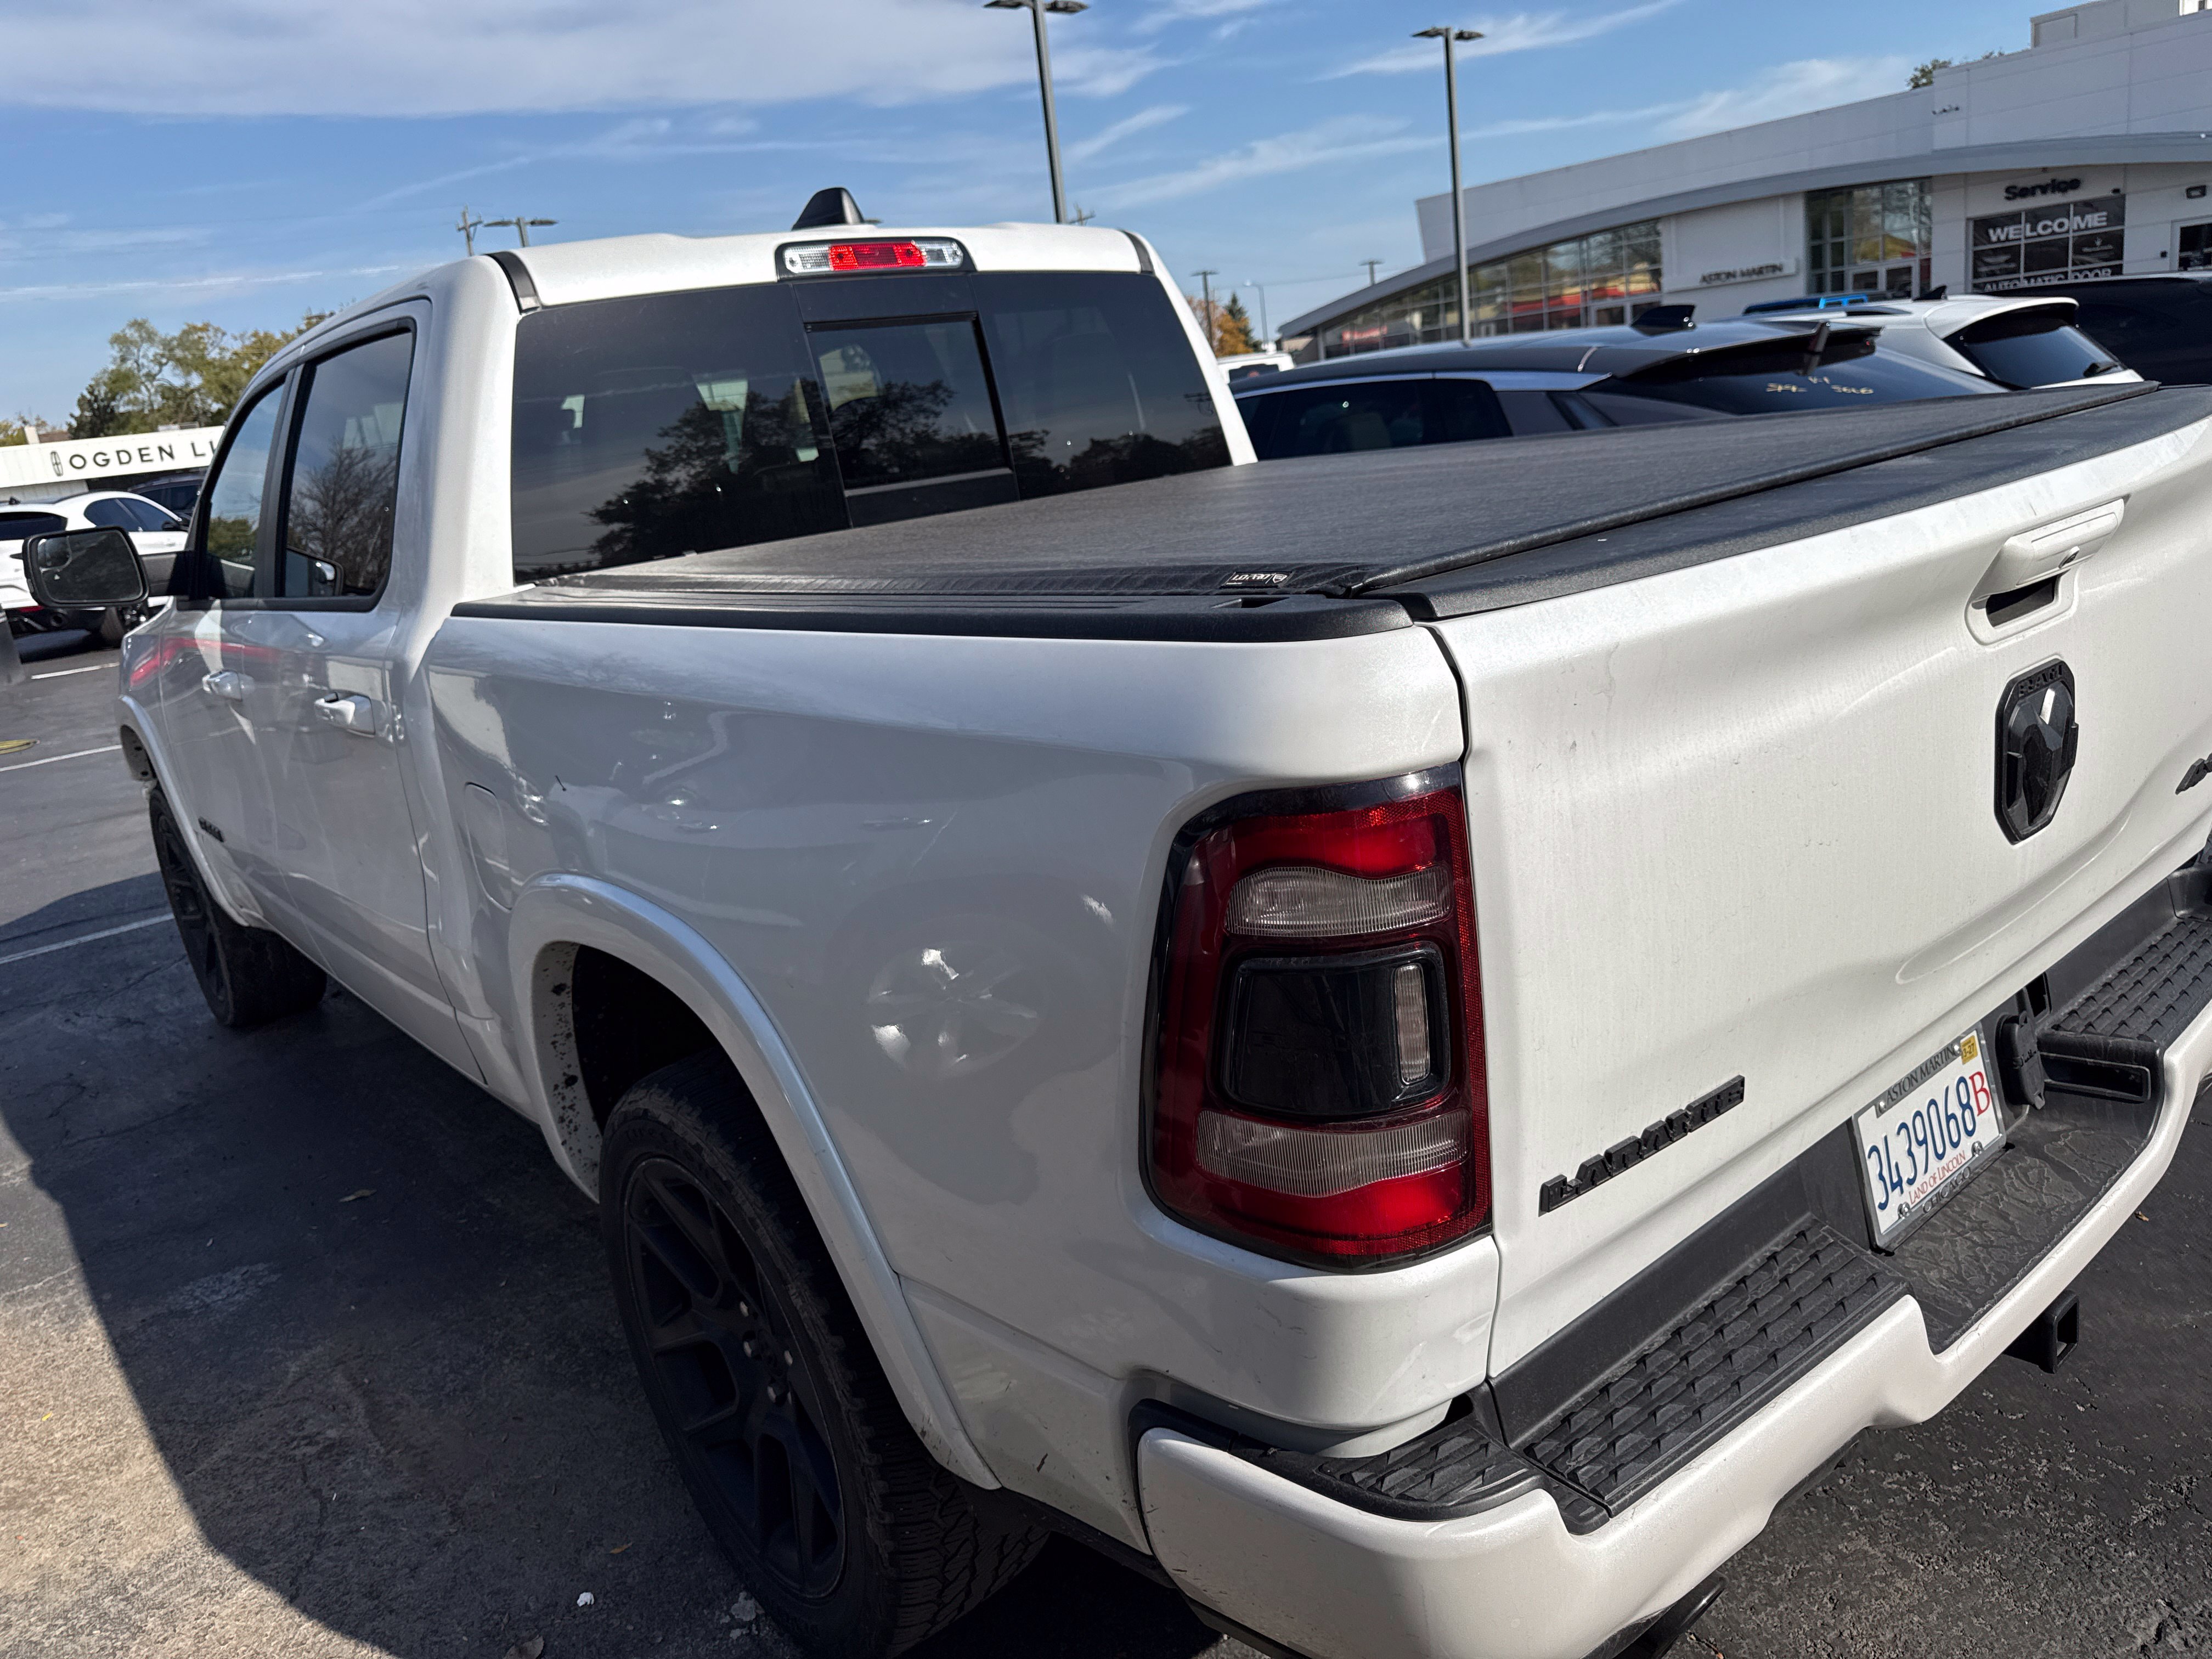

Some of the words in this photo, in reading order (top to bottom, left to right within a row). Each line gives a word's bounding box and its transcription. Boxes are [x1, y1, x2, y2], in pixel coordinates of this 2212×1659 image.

[2004, 178, 2081, 201] Service
[1988, 211, 2108, 242] WELCOME
[69, 443, 175, 470] OGDEN
[1887, 1071, 1918, 1105] ASTON
[1920, 1042, 1957, 1080] MARTIN
[1538, 1074, 1745, 1217] LARAMIE
[1867, 1070, 1991, 1211] 3439068B
[1909, 1181, 1928, 1205] LAND
[1928, 1172, 1937, 1188] OF
[1937, 1149, 1966, 1181] LINCOLN
[1922, 1166, 1971, 1214] CHICAGO
